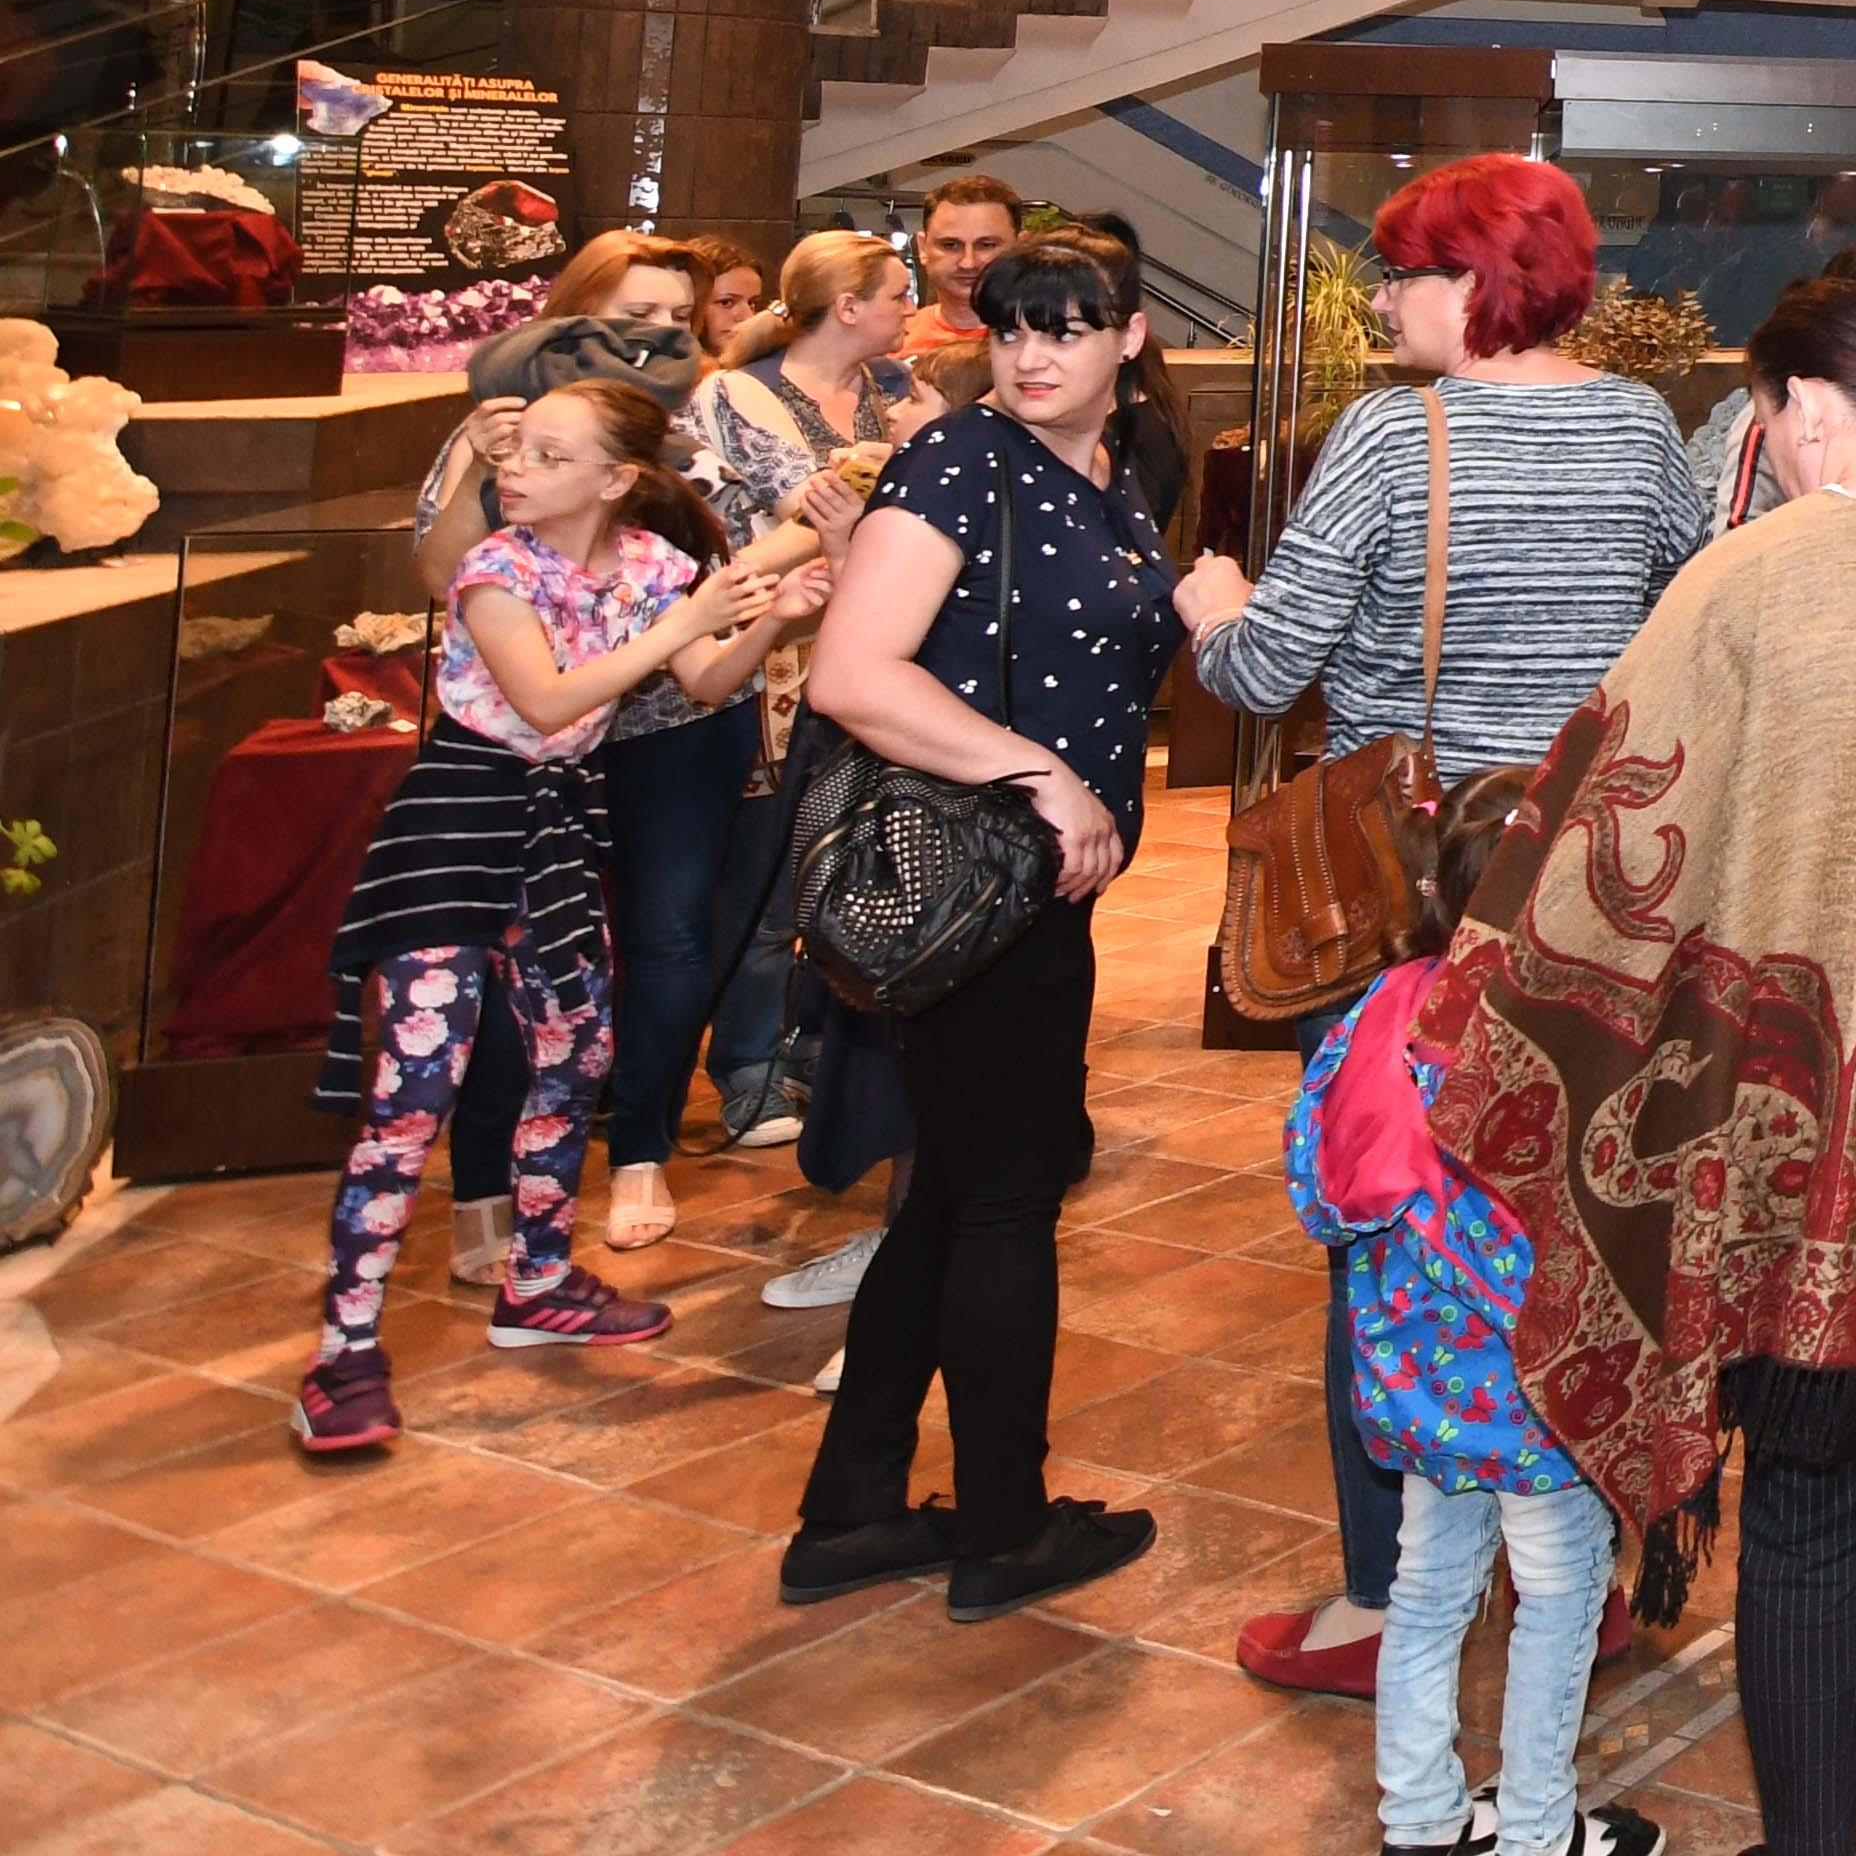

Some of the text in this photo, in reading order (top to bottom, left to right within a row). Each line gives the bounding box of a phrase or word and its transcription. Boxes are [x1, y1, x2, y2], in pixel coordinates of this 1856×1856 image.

[376, 71, 535, 91] GENERALITĂȚI ASUPRA
[351, 83, 444, 99] CRISTALELOR
[464, 89, 559, 104] MINERALELOR
